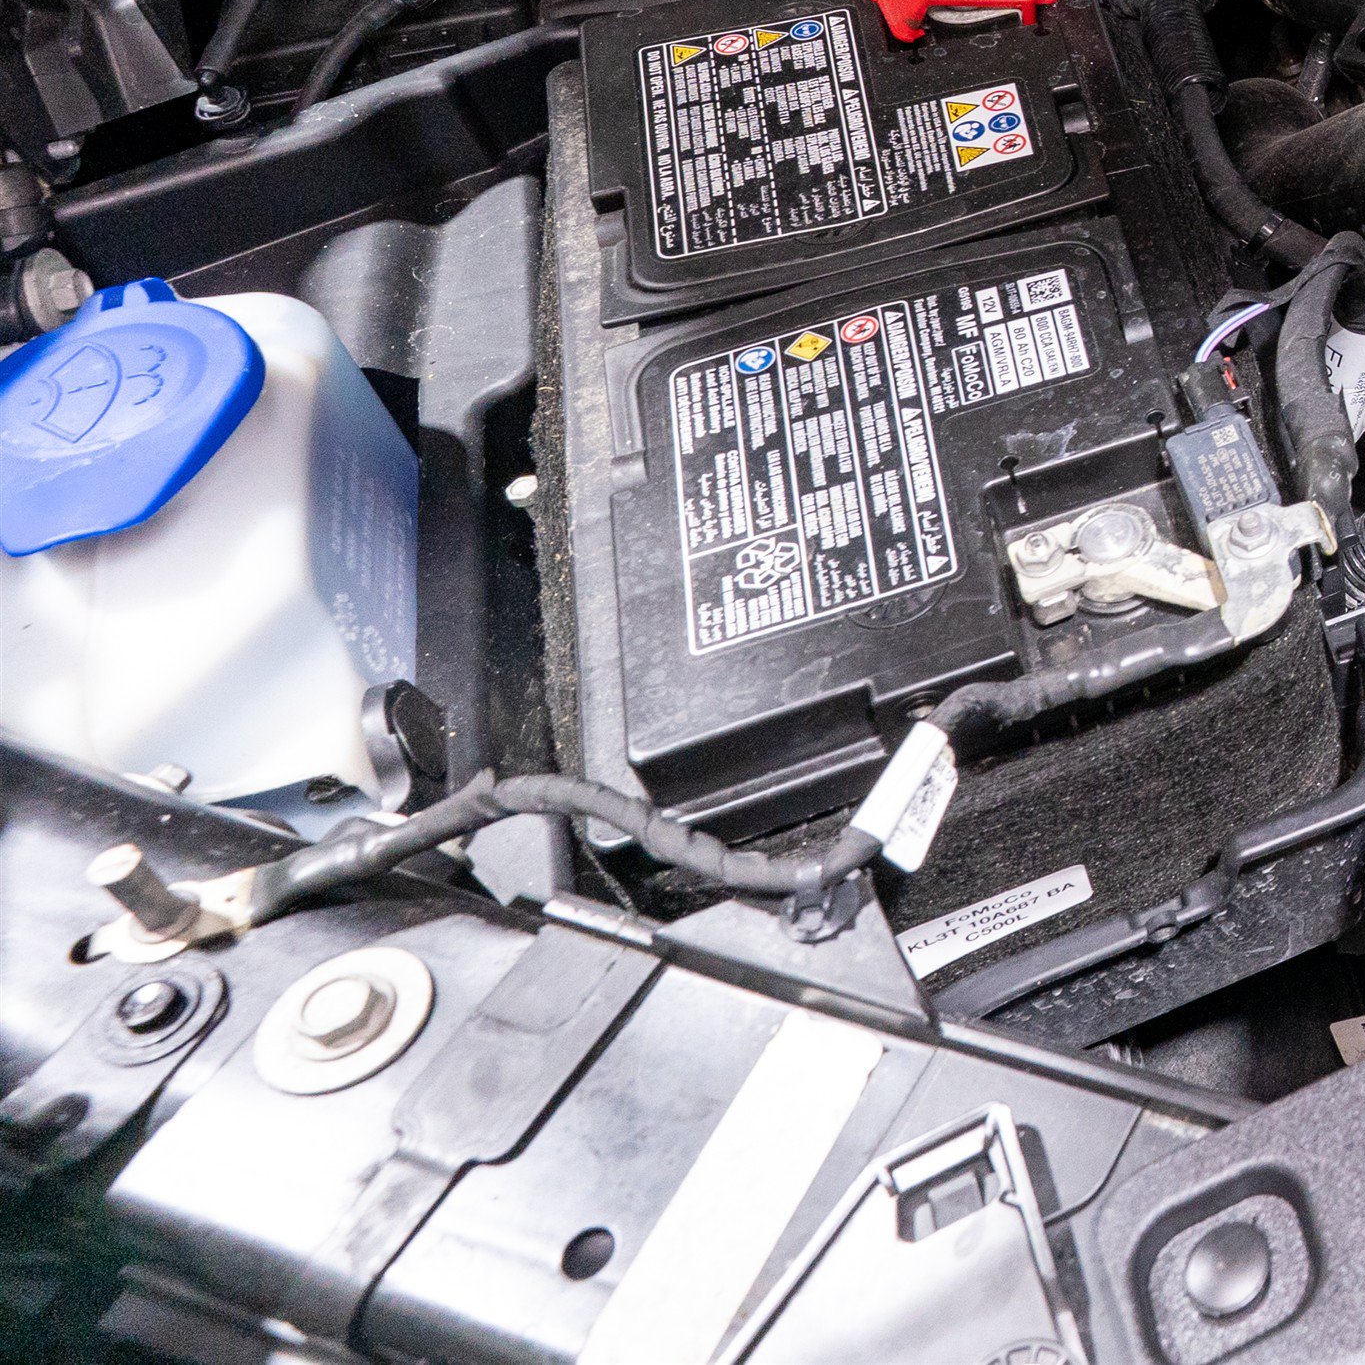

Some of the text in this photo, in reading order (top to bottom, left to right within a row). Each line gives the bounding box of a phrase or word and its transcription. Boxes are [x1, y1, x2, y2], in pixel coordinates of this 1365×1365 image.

[647, 50, 663, 97] DO NOT OPEN.
[831, 24, 854, 81] DANGER/POISON
[652, 98, 669, 152] NE PAS OUVRIR.
[845, 98, 869, 159] PELIGRO/VENENO
[657, 154, 674, 200] NO LA ABRA.
[956, 314, 978, 337] MF
[982, 296, 996, 312] 12V
[1035, 316, 1049, 331] 800
[887, 322, 916, 398] DANGER/POISON
[990, 332, 1011, 386] AGM/VRLA
[1013, 326, 1034, 376] 80 Ah C20
[1039, 331, 1053, 348] CCA
[676, 377, 687, 395] ANTI
[718, 365, 735, 427] NON-SPILLABLE
[959, 345, 983, 400] FoMoCo
[904, 419, 934, 502] PELIGRO/VENENO
[907, 882, 1075, 954] KL3T 10A687 BA
[944, 890, 1033, 927] FoMoCo
[965, 914, 1029, 943] C500L
